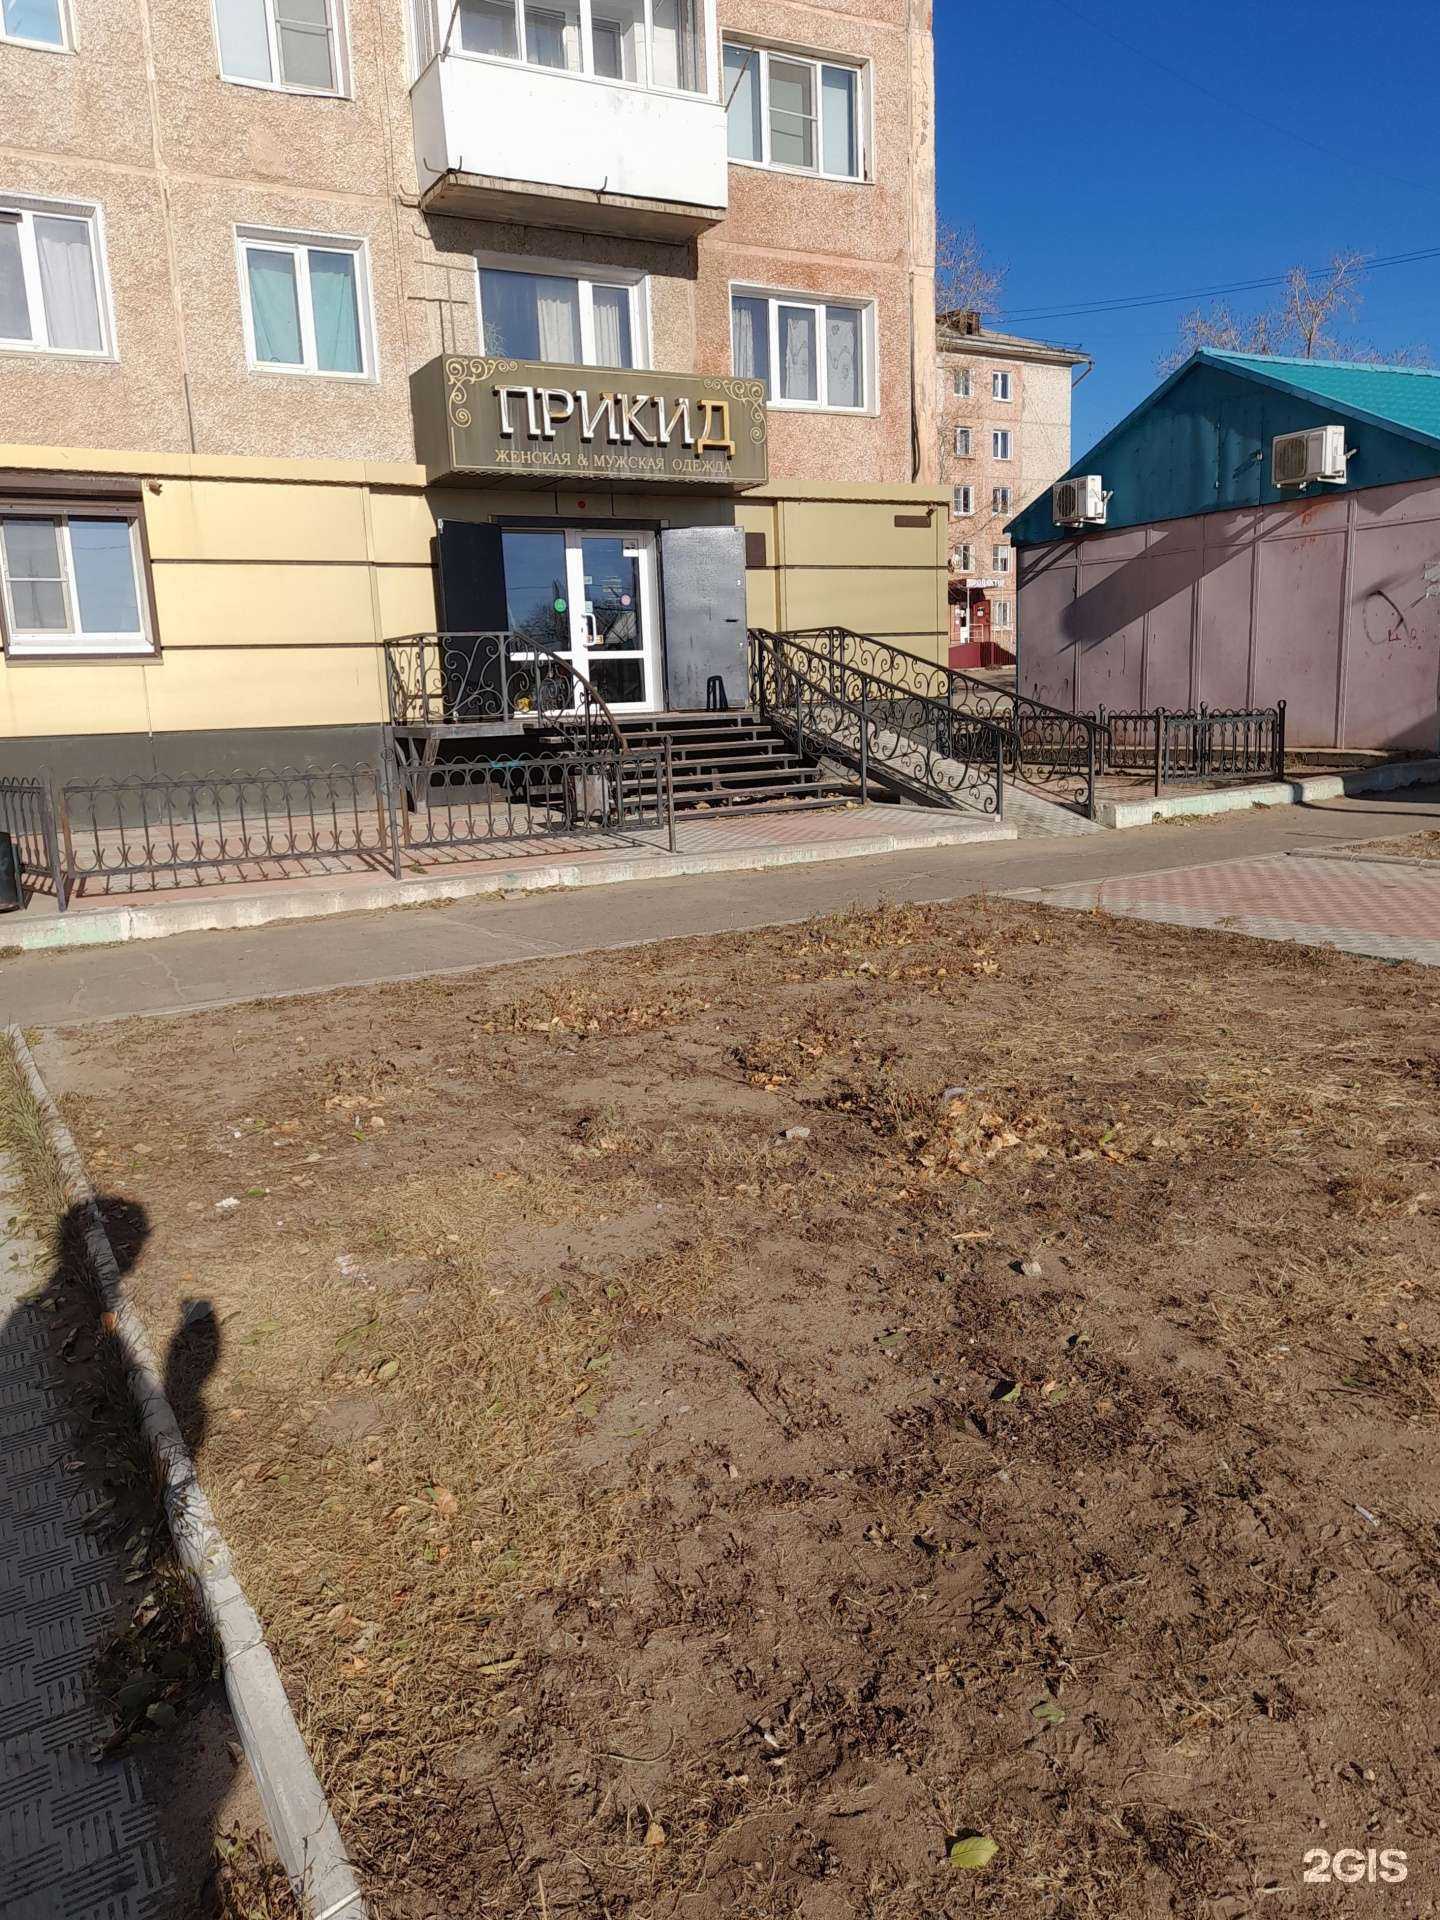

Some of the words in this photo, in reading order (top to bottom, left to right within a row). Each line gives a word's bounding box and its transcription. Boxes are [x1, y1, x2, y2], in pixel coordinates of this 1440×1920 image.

[494, 385, 736, 456] ПРИКИД
[495, 449, 571, 466] ЖЕНСКАЯ
[577, 453, 589, 467] &
[593, 455, 665, 470] МУЖСКАЯ
[672, 459, 732, 473] ОДЕЖДА
